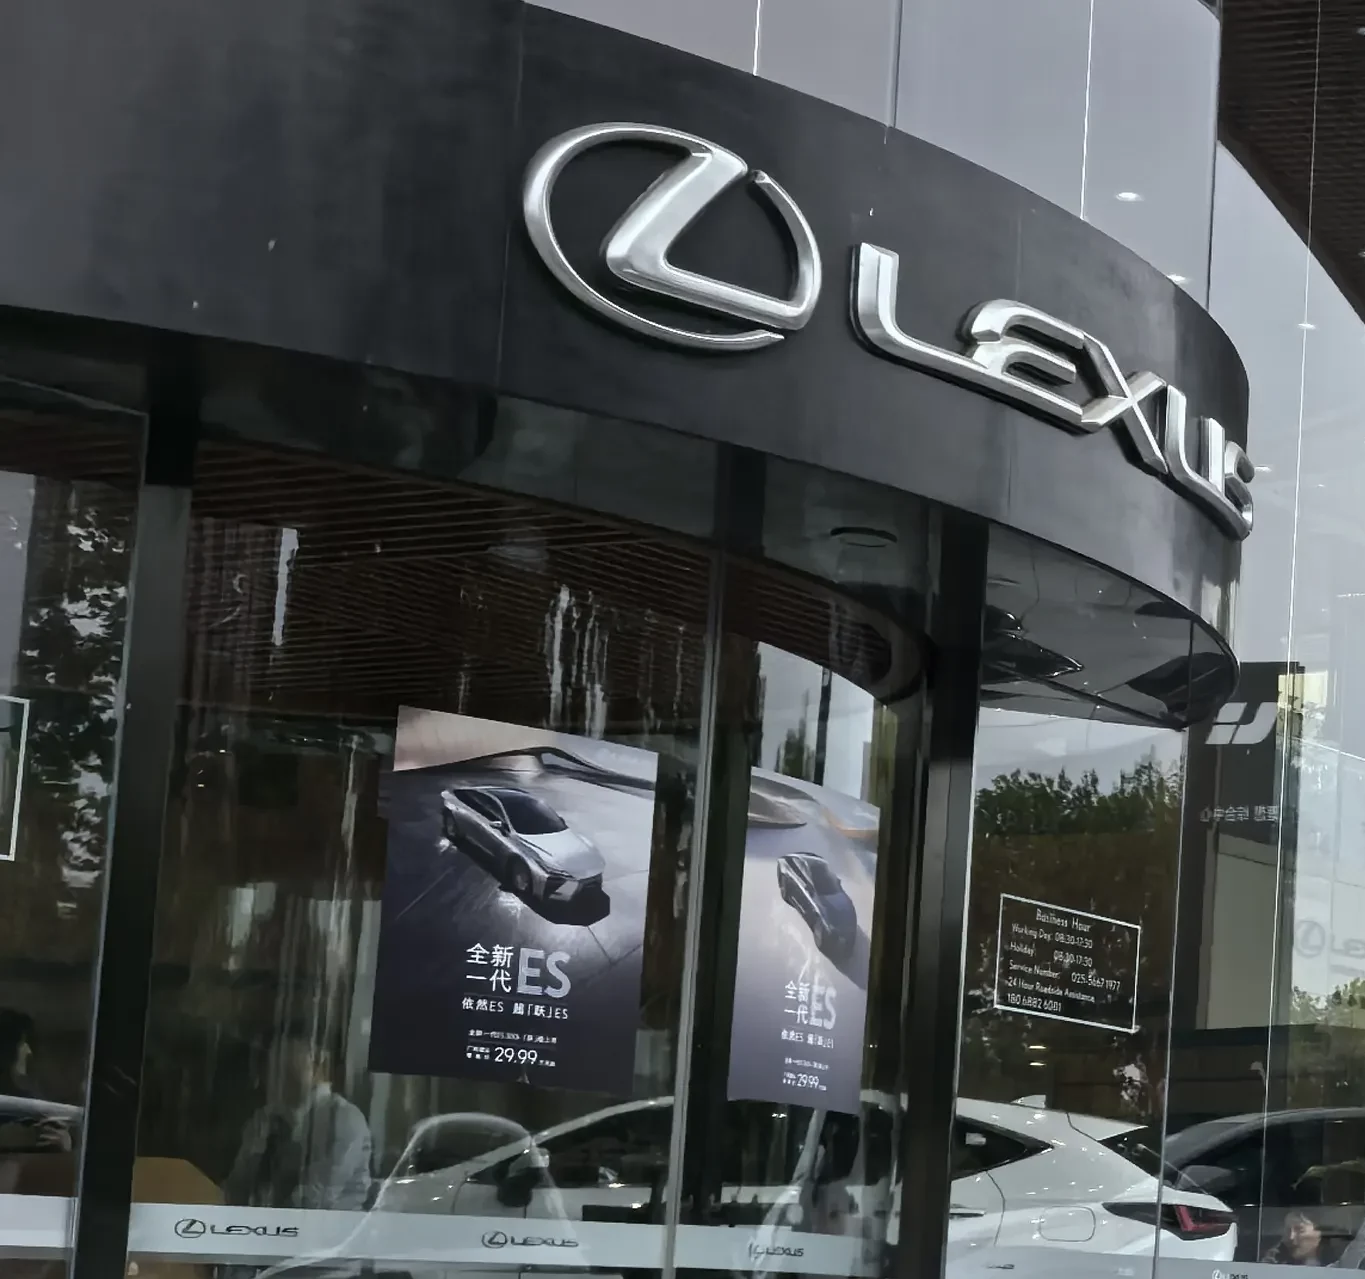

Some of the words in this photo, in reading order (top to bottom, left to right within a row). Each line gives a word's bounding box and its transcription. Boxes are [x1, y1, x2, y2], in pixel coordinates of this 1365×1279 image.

[849, 242, 1256, 540] LEXUS
[466, 942, 514, 968] 全新
[466, 969, 512, 993] 一代
[517, 947, 571, 998] ES
[809, 985, 837, 1030] ES
[494, 1046, 538, 1065] 29.99
[210, 1224, 299, 1237] LEXUS
[510, 1235, 579, 1248] LEXUS
